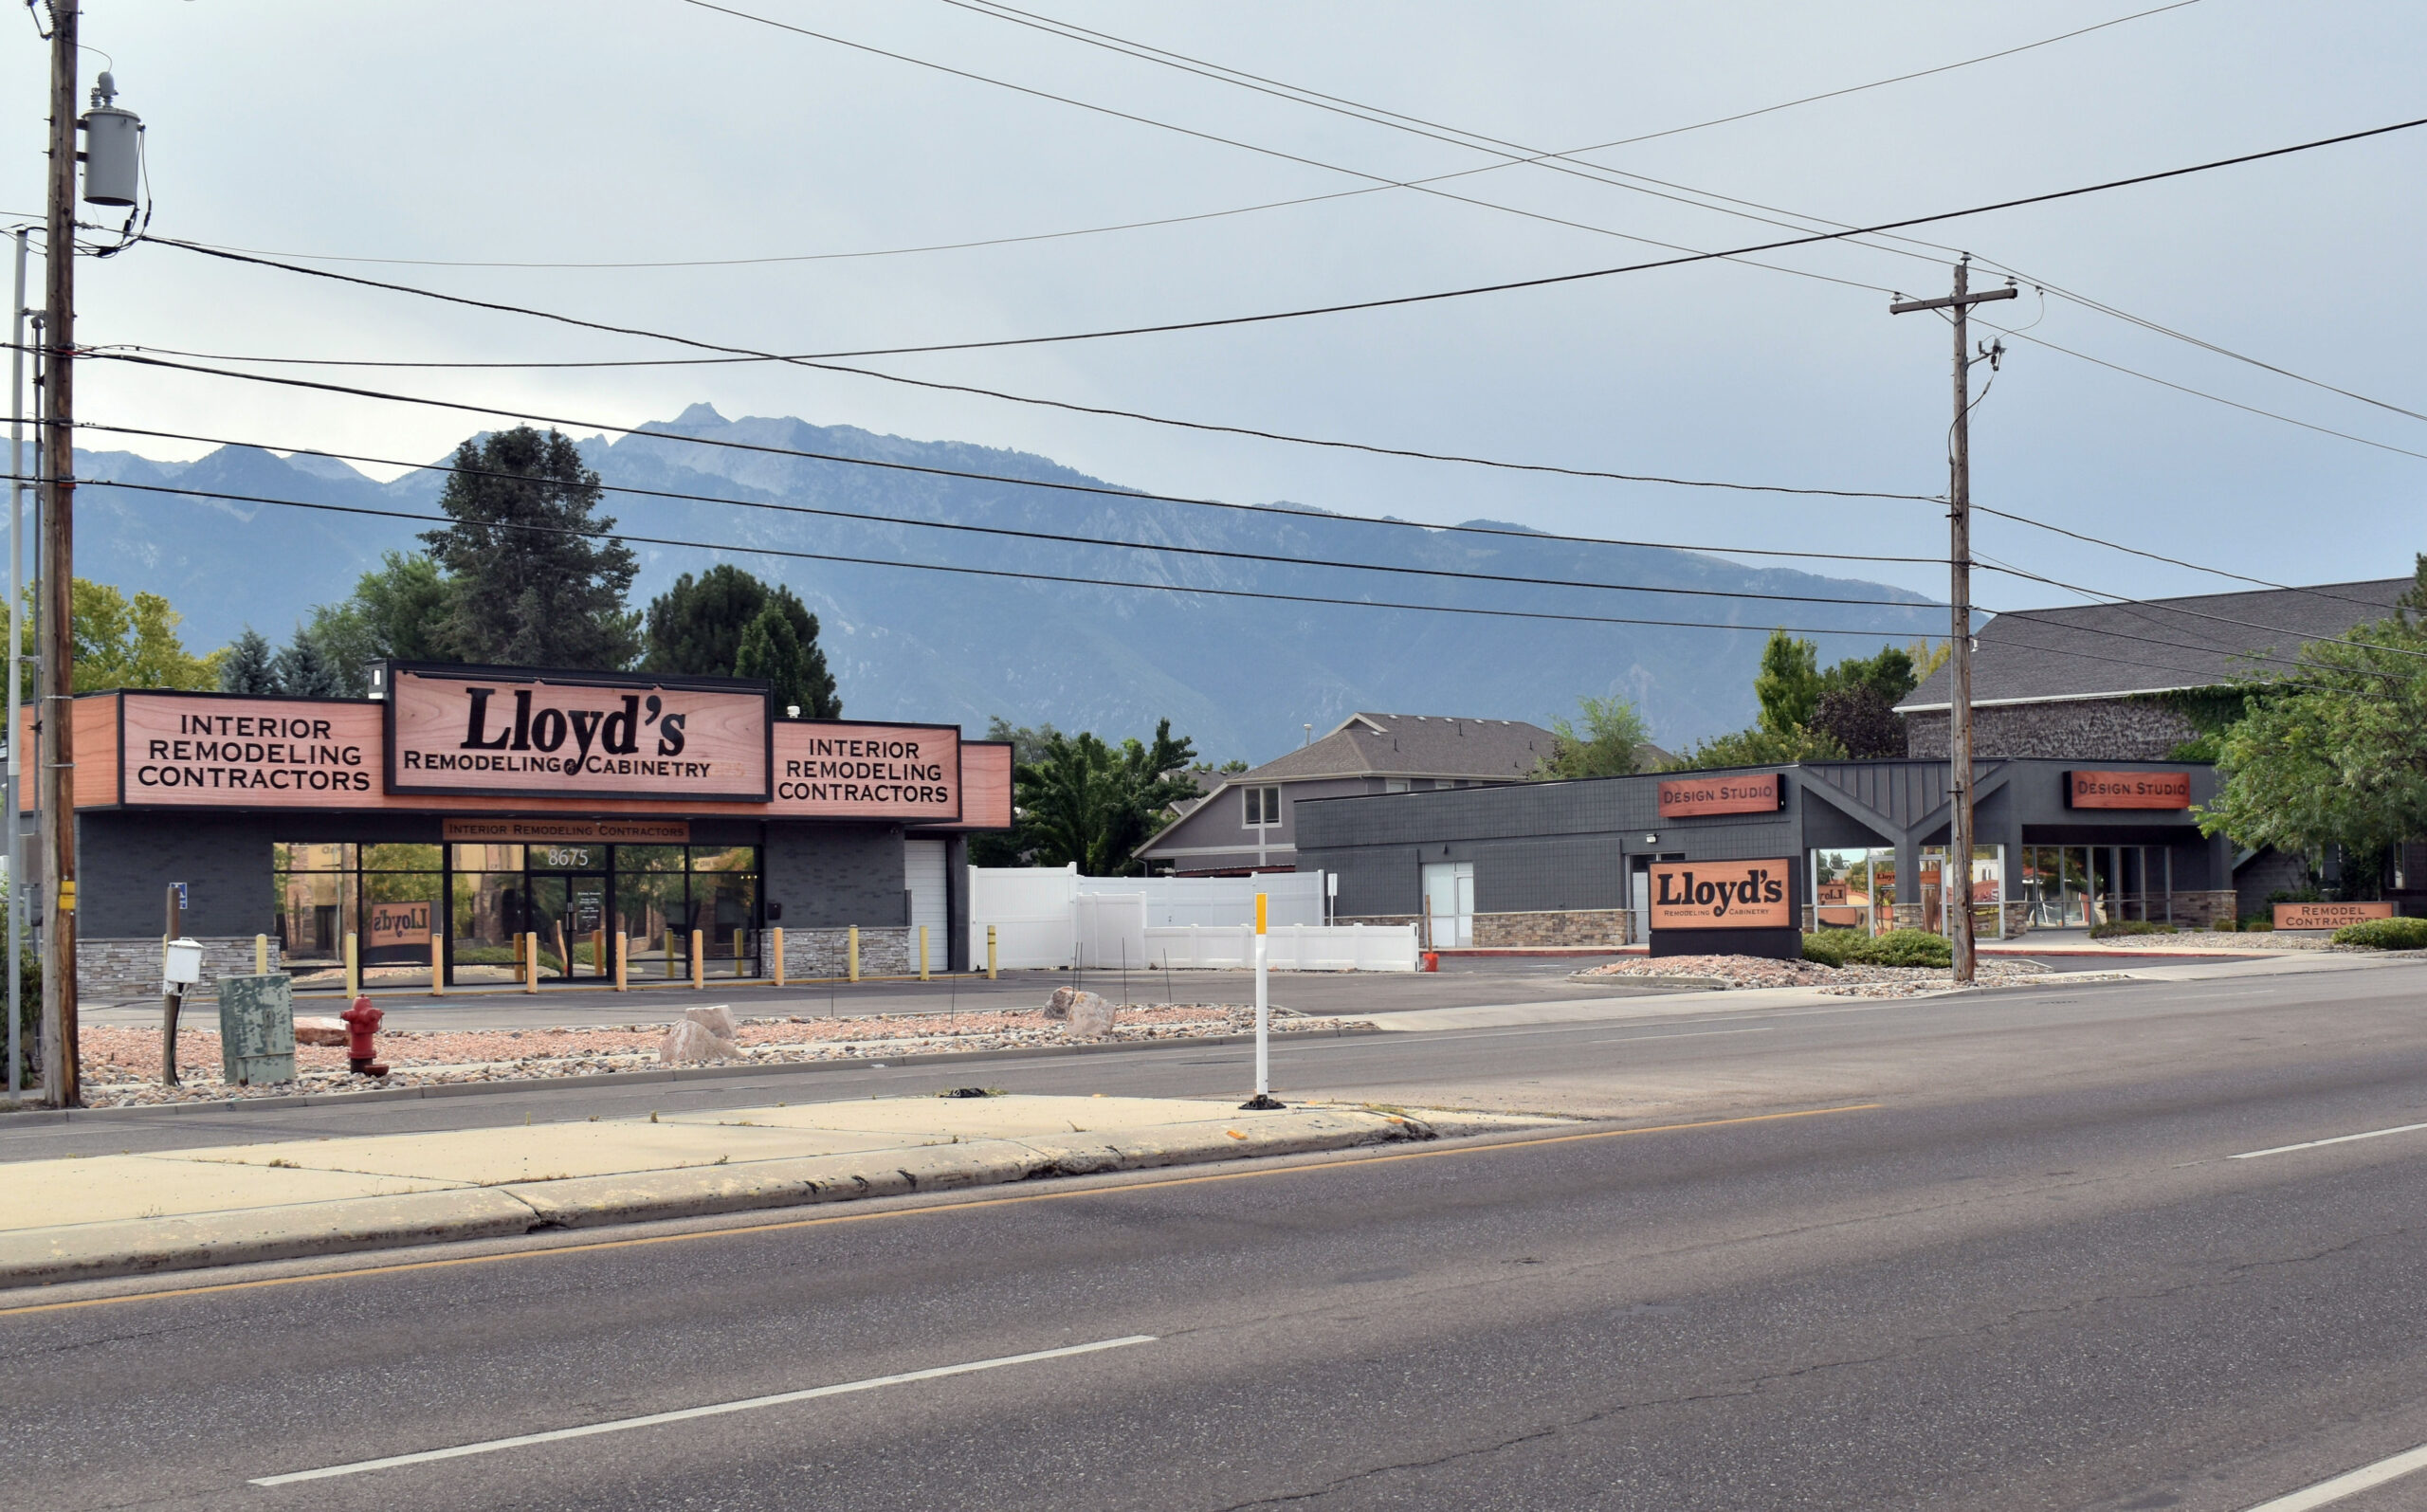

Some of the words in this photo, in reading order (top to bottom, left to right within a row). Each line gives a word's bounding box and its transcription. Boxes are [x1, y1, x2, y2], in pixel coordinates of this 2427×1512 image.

[180, 714, 331, 739] INTERIOR
[460, 686, 686, 776] Lloyd's
[149, 739, 362, 766] REMODELING
[809, 738, 920, 759] INTERIOR
[403, 751, 561, 773] REMODELING
[585, 756, 711, 777] CABINETRY
[786, 760, 941, 781] REMODELING
[137, 765, 371, 791] CONTRACTORS
[2078, 780, 2130, 794] DESIGN
[2137, 782, 2186, 795] STUDIO
[778, 782, 948, 803] CONTRACTORS
[1664, 790, 1714, 804] DESIGN
[1720, 786, 1773, 799] STUDIO
[448, 823, 508, 835] INTERIOR
[513, 824, 593, 836] REMODELING
[598, 825, 684, 837] CONTRACTORS
[548, 848, 589, 866] 8675
[1656, 868, 1783, 918] Lloyd's
[2286, 917, 2381, 926] CONTRACTO
[2301, 906, 2365, 916] REMODEL
